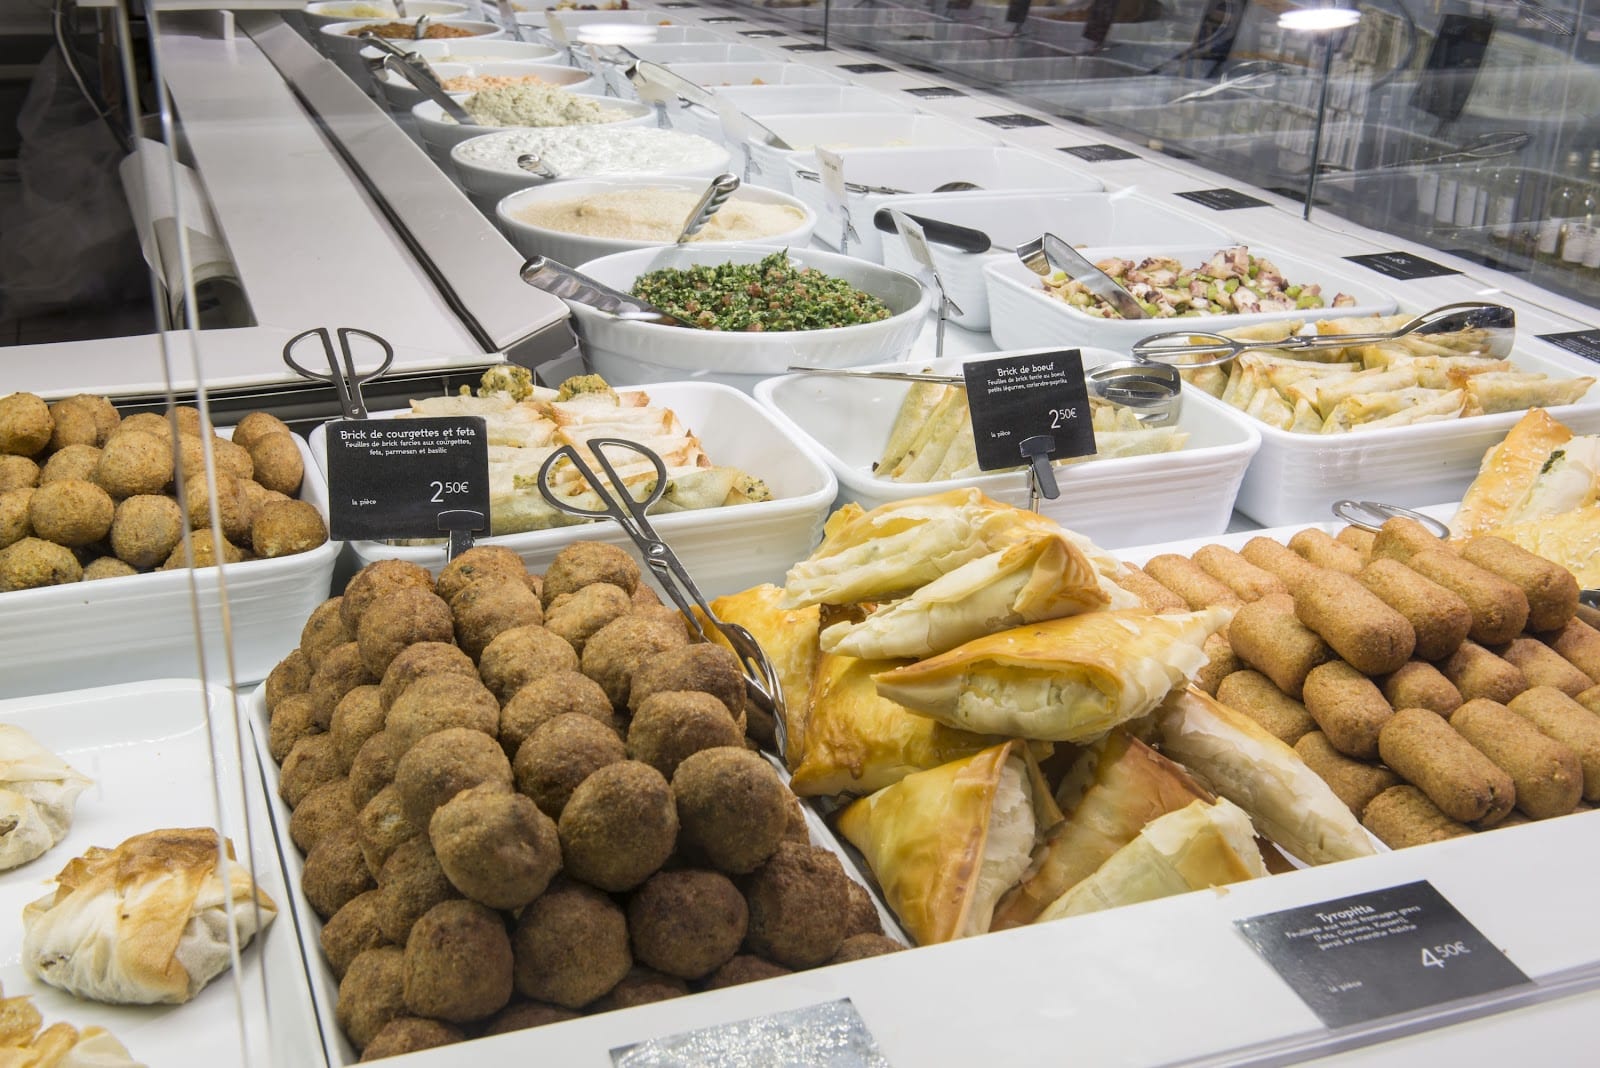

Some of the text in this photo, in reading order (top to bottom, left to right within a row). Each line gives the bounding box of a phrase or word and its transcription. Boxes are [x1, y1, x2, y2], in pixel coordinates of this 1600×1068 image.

[997, 367, 1018, 376] Brick
[1020, 366, 1030, 374] de
[988, 386, 1002, 394] petits
[340, 426, 476, 440] Brick de courgettes et feta
[436, 438, 472, 447] courgettes,
[360, 498, 376, 506] pièce
[1315, 904, 1376, 924] Tyropitta
